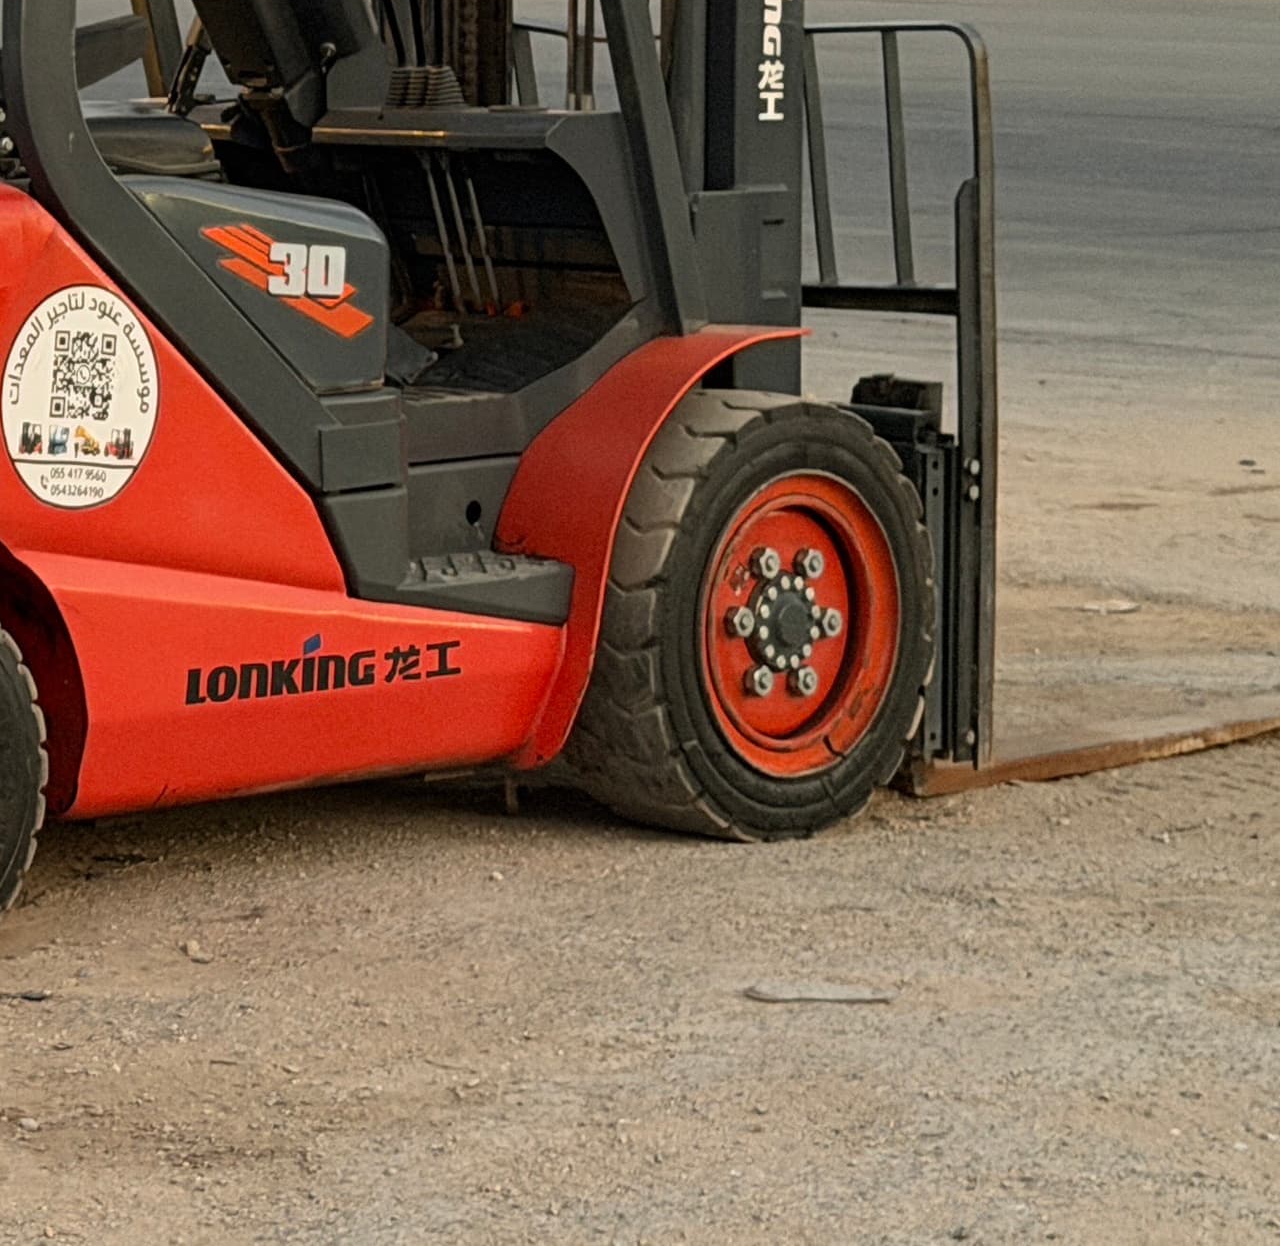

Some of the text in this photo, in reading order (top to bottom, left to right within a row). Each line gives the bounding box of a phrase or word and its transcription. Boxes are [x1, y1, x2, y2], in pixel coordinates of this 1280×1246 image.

[267, 241, 347, 298] 30
[49, 467, 107, 483] 055 417 9560
[50, 483, 104, 498] 0543264190
[184, 632, 462, 706] LONKING 龙工
